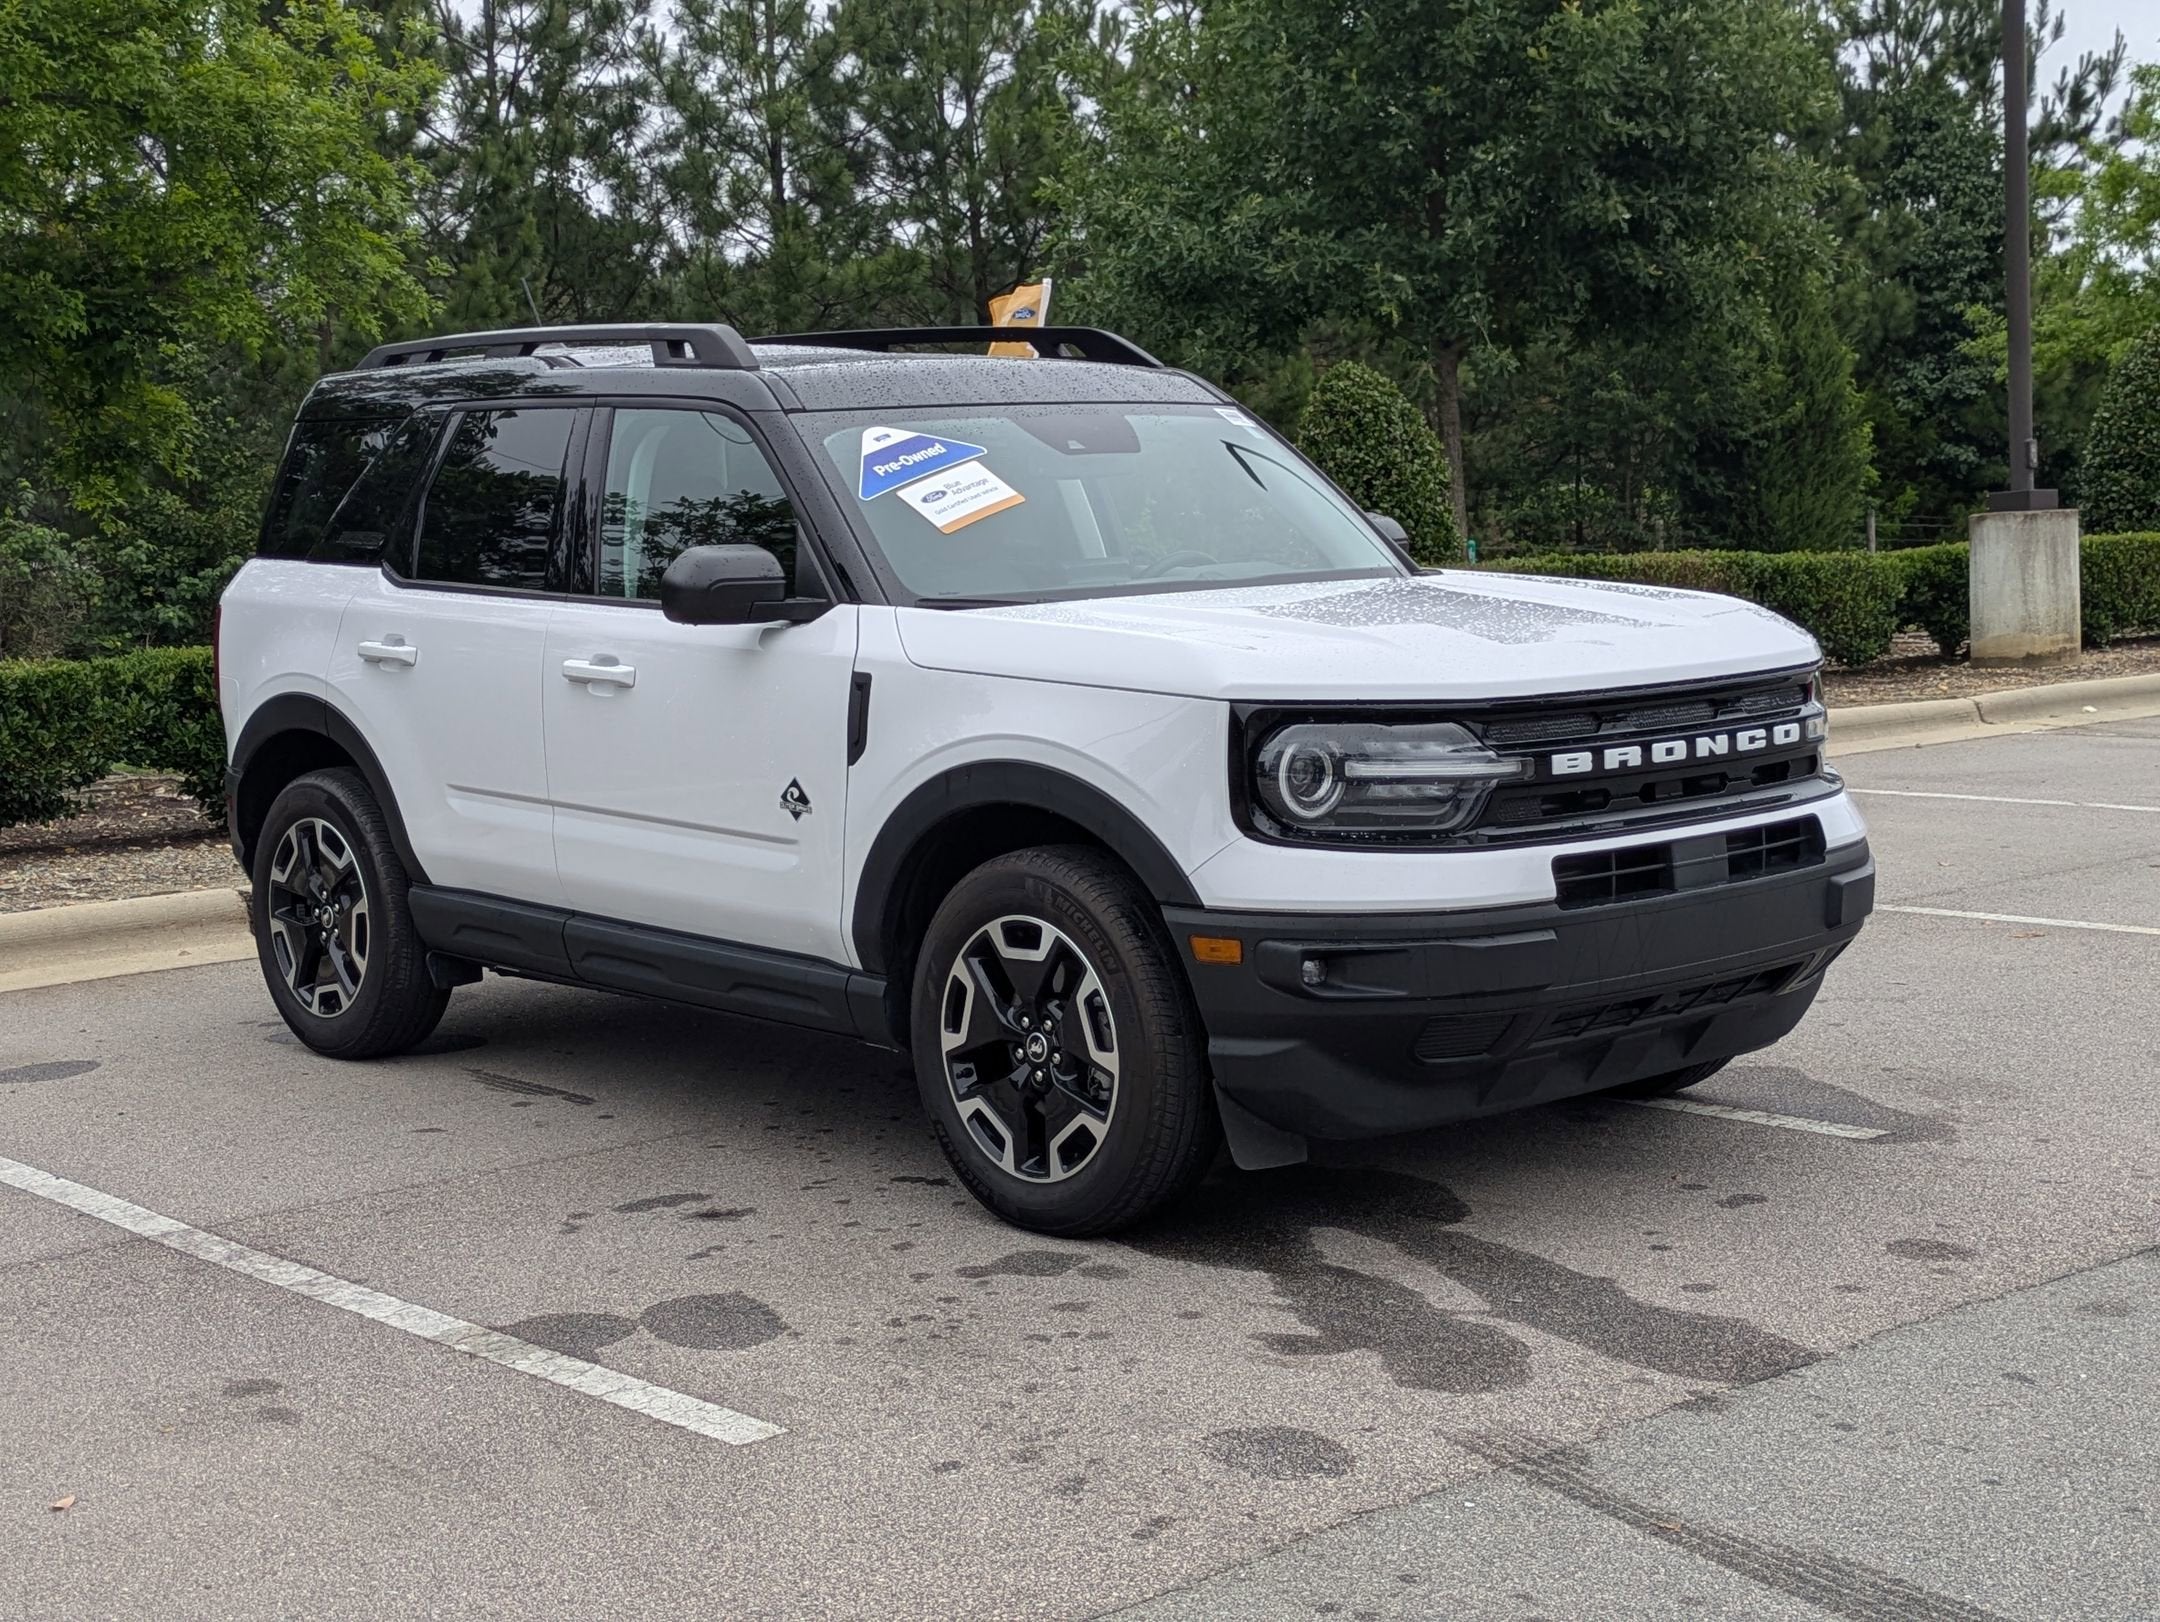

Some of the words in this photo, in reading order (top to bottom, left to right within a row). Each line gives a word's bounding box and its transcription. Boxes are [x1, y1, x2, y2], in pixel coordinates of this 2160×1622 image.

[873, 442, 947, 477] Pre-Owned
[1551, 723, 1800, 775] BRONCO
[1054, 894, 1118, 972] MICHELIN
